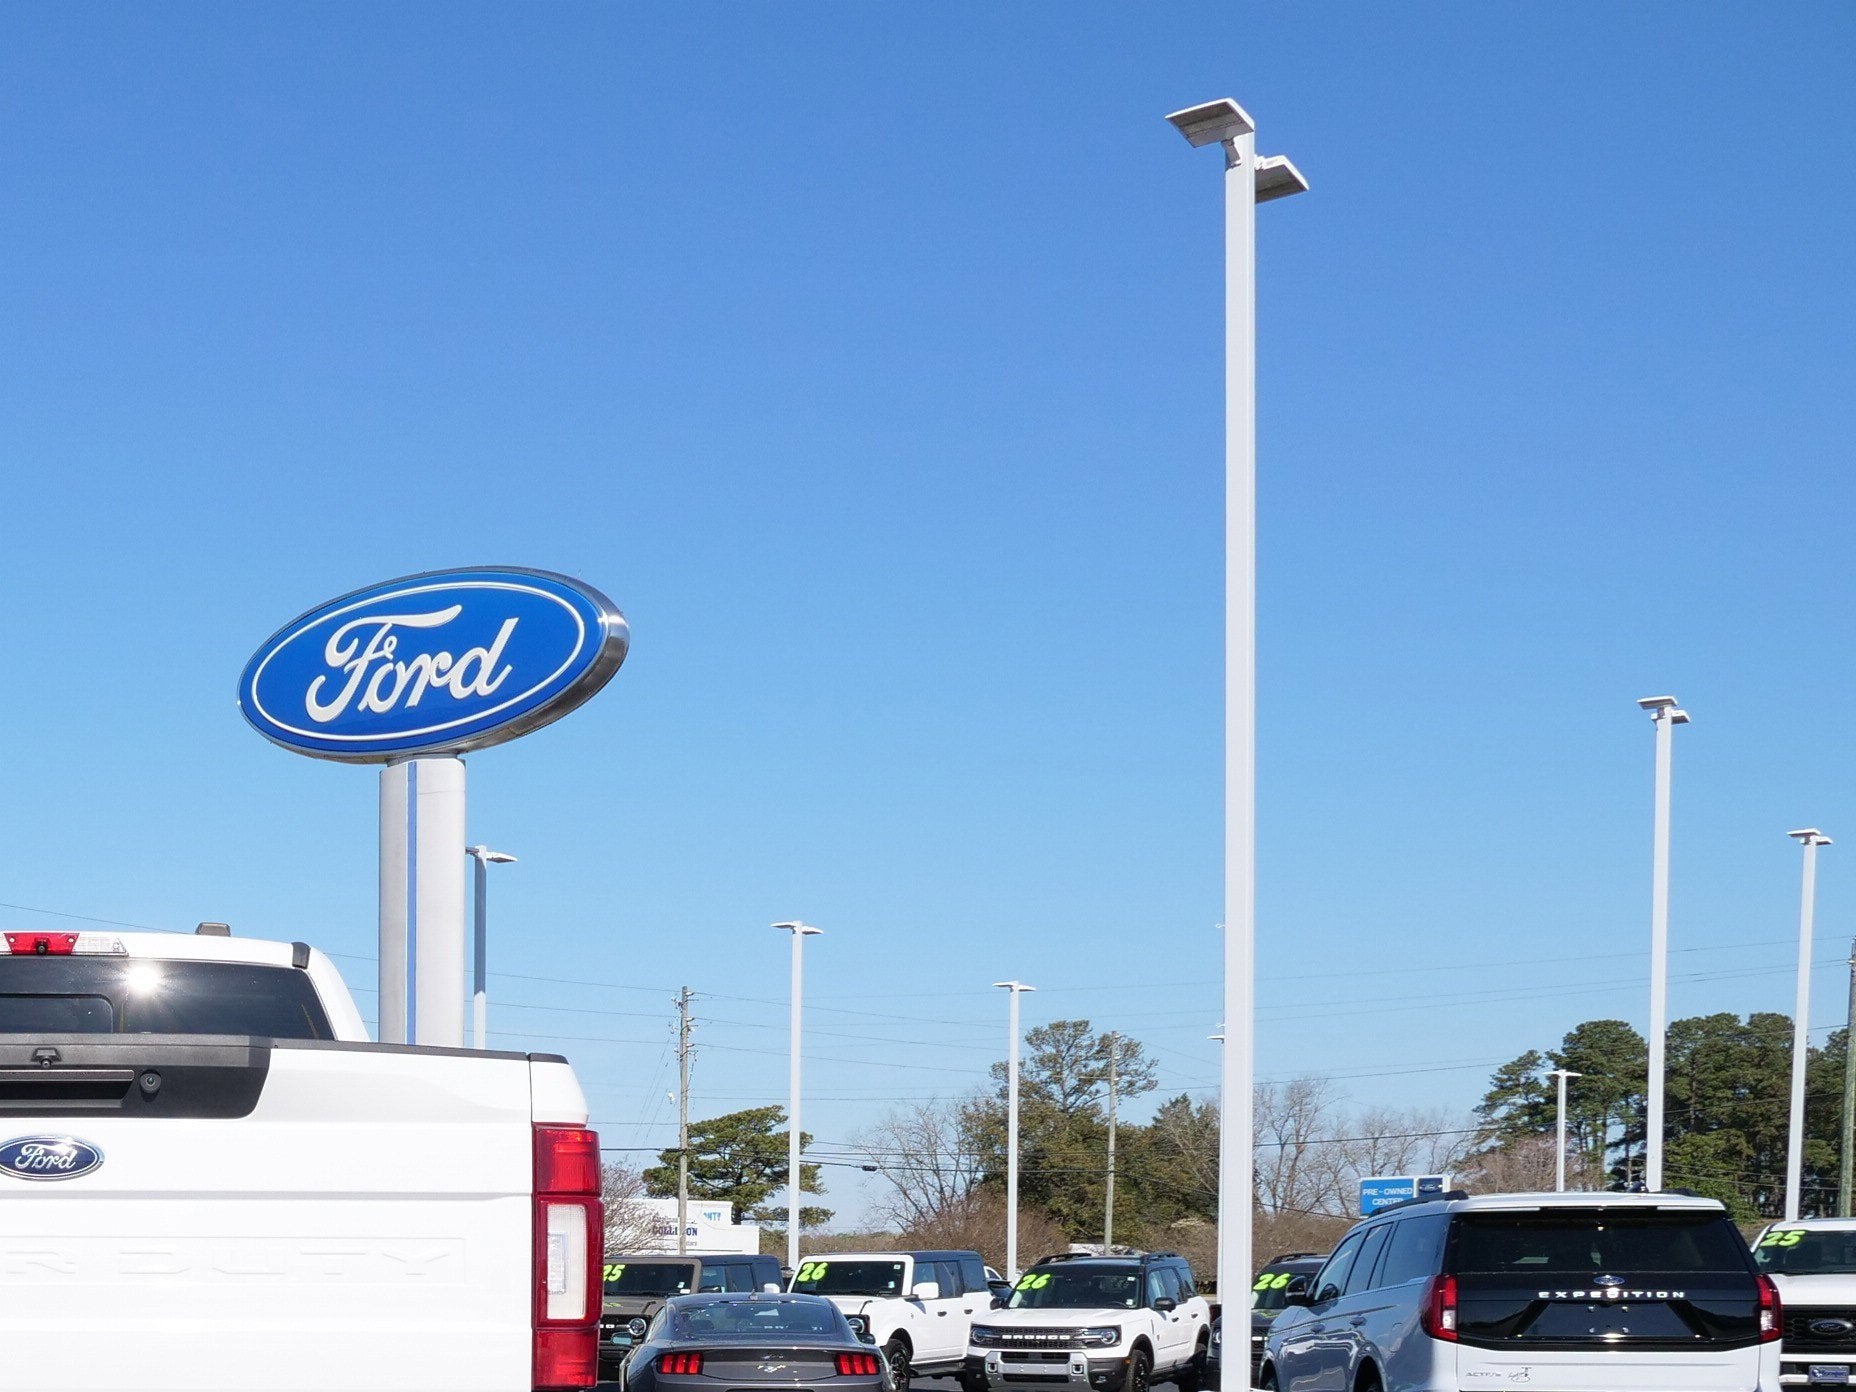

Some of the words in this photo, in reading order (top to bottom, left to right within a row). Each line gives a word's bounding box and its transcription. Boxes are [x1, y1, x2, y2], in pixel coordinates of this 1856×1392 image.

[305, 604, 519, 722] Ford
[15, 1143, 78, 1169] Ford
[1760, 1230, 1806, 1246] 25
[118, 1248, 450, 1276] DUTY
[603, 1264, 626, 1281] 25
[797, 1262, 828, 1282] 26
[1017, 1274, 1051, 1290] 26
[1253, 1273, 1291, 1290] 26
[1538, 1291, 1685, 1299] EXPEDITION
